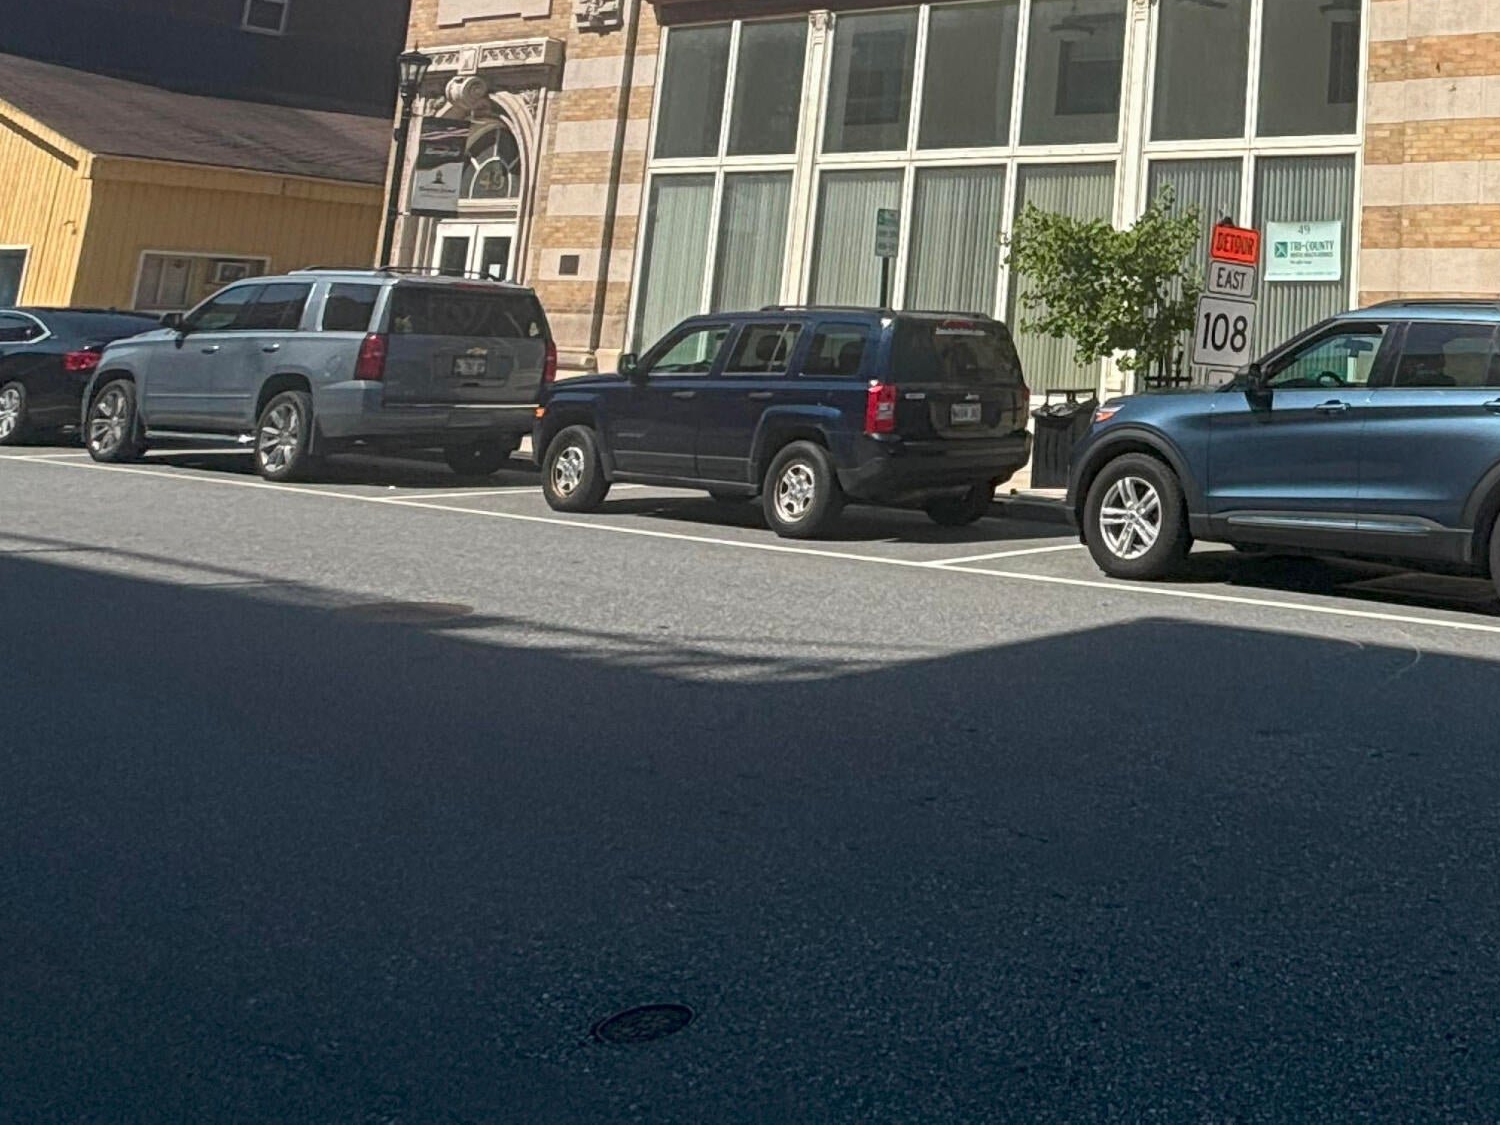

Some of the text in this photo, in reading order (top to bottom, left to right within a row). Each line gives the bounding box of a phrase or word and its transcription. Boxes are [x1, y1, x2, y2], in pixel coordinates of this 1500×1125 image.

[1298, 224, 1311, 235] 49
[1216, 232, 1255, 256] DETOUR
[1289, 240, 1335, 252] TRI-COUNTY
[1216, 266, 1247, 291] EAST
[1202, 311, 1248, 353] 108
